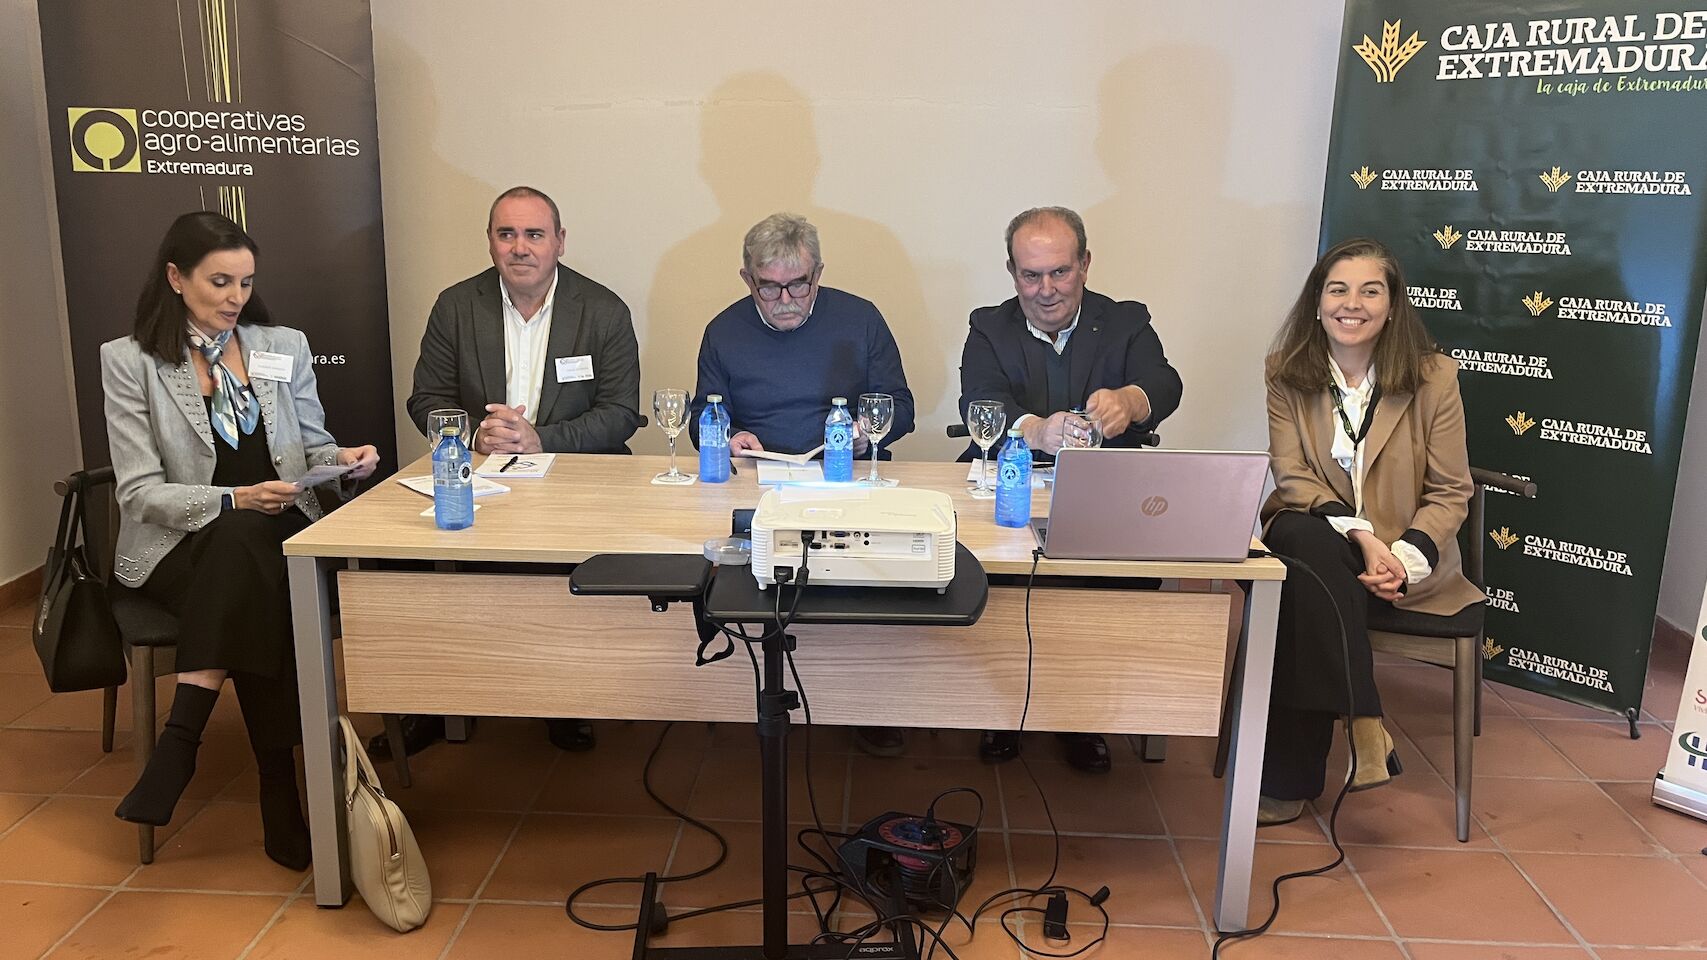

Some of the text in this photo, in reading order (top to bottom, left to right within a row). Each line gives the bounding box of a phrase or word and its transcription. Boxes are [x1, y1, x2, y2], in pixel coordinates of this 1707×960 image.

[1440, 10, 1707, 53] CAJA RURAL DE
[1537, 78, 1552, 95] La
[1557, 79, 1589, 97] caja
[1592, 78, 1612, 93] de
[141, 109, 306, 132] cooperativas
[144, 132, 360, 158] agro-alimentarias
[146, 159, 254, 176] Extremadura
[1382, 169, 1474, 181] CAJA RURAL DE
[1577, 170, 1686, 184] CAJA RURAL DE
[1381, 179, 1479, 191] EXTREMADURA
[1575, 181, 1692, 196] EXTREMADURA
[1467, 229, 1567, 244] CAJA RURAL DE
[1465, 240, 1572, 256] EXTREMADURA
[1406, 286, 1458, 300] URAL DE
[1408, 296, 1463, 311] MADURA
[1559, 297, 1666, 315] CAJA RURAL DE
[1557, 307, 1673, 327] EXTREMADURA
[1450, 348, 1548, 368] CAJA RURAL DE
[1458, 359, 1554, 380] XTREMADURA
[1541, 418, 1648, 442] CAJA RURAL DE
[1539, 428, 1653, 455] EXTREMADURA
[1145, 496, 1166, 516] hp
[1524, 535, 1628, 564] CAJA RURAL DE
[1522, 544, 1634, 576] EXTREMADURA
[1495, 588, 1515, 602] DE
[1509, 647, 1609, 681] CAJA RURAL DE
[1507, 656, 1615, 694] EXTREMADURA
